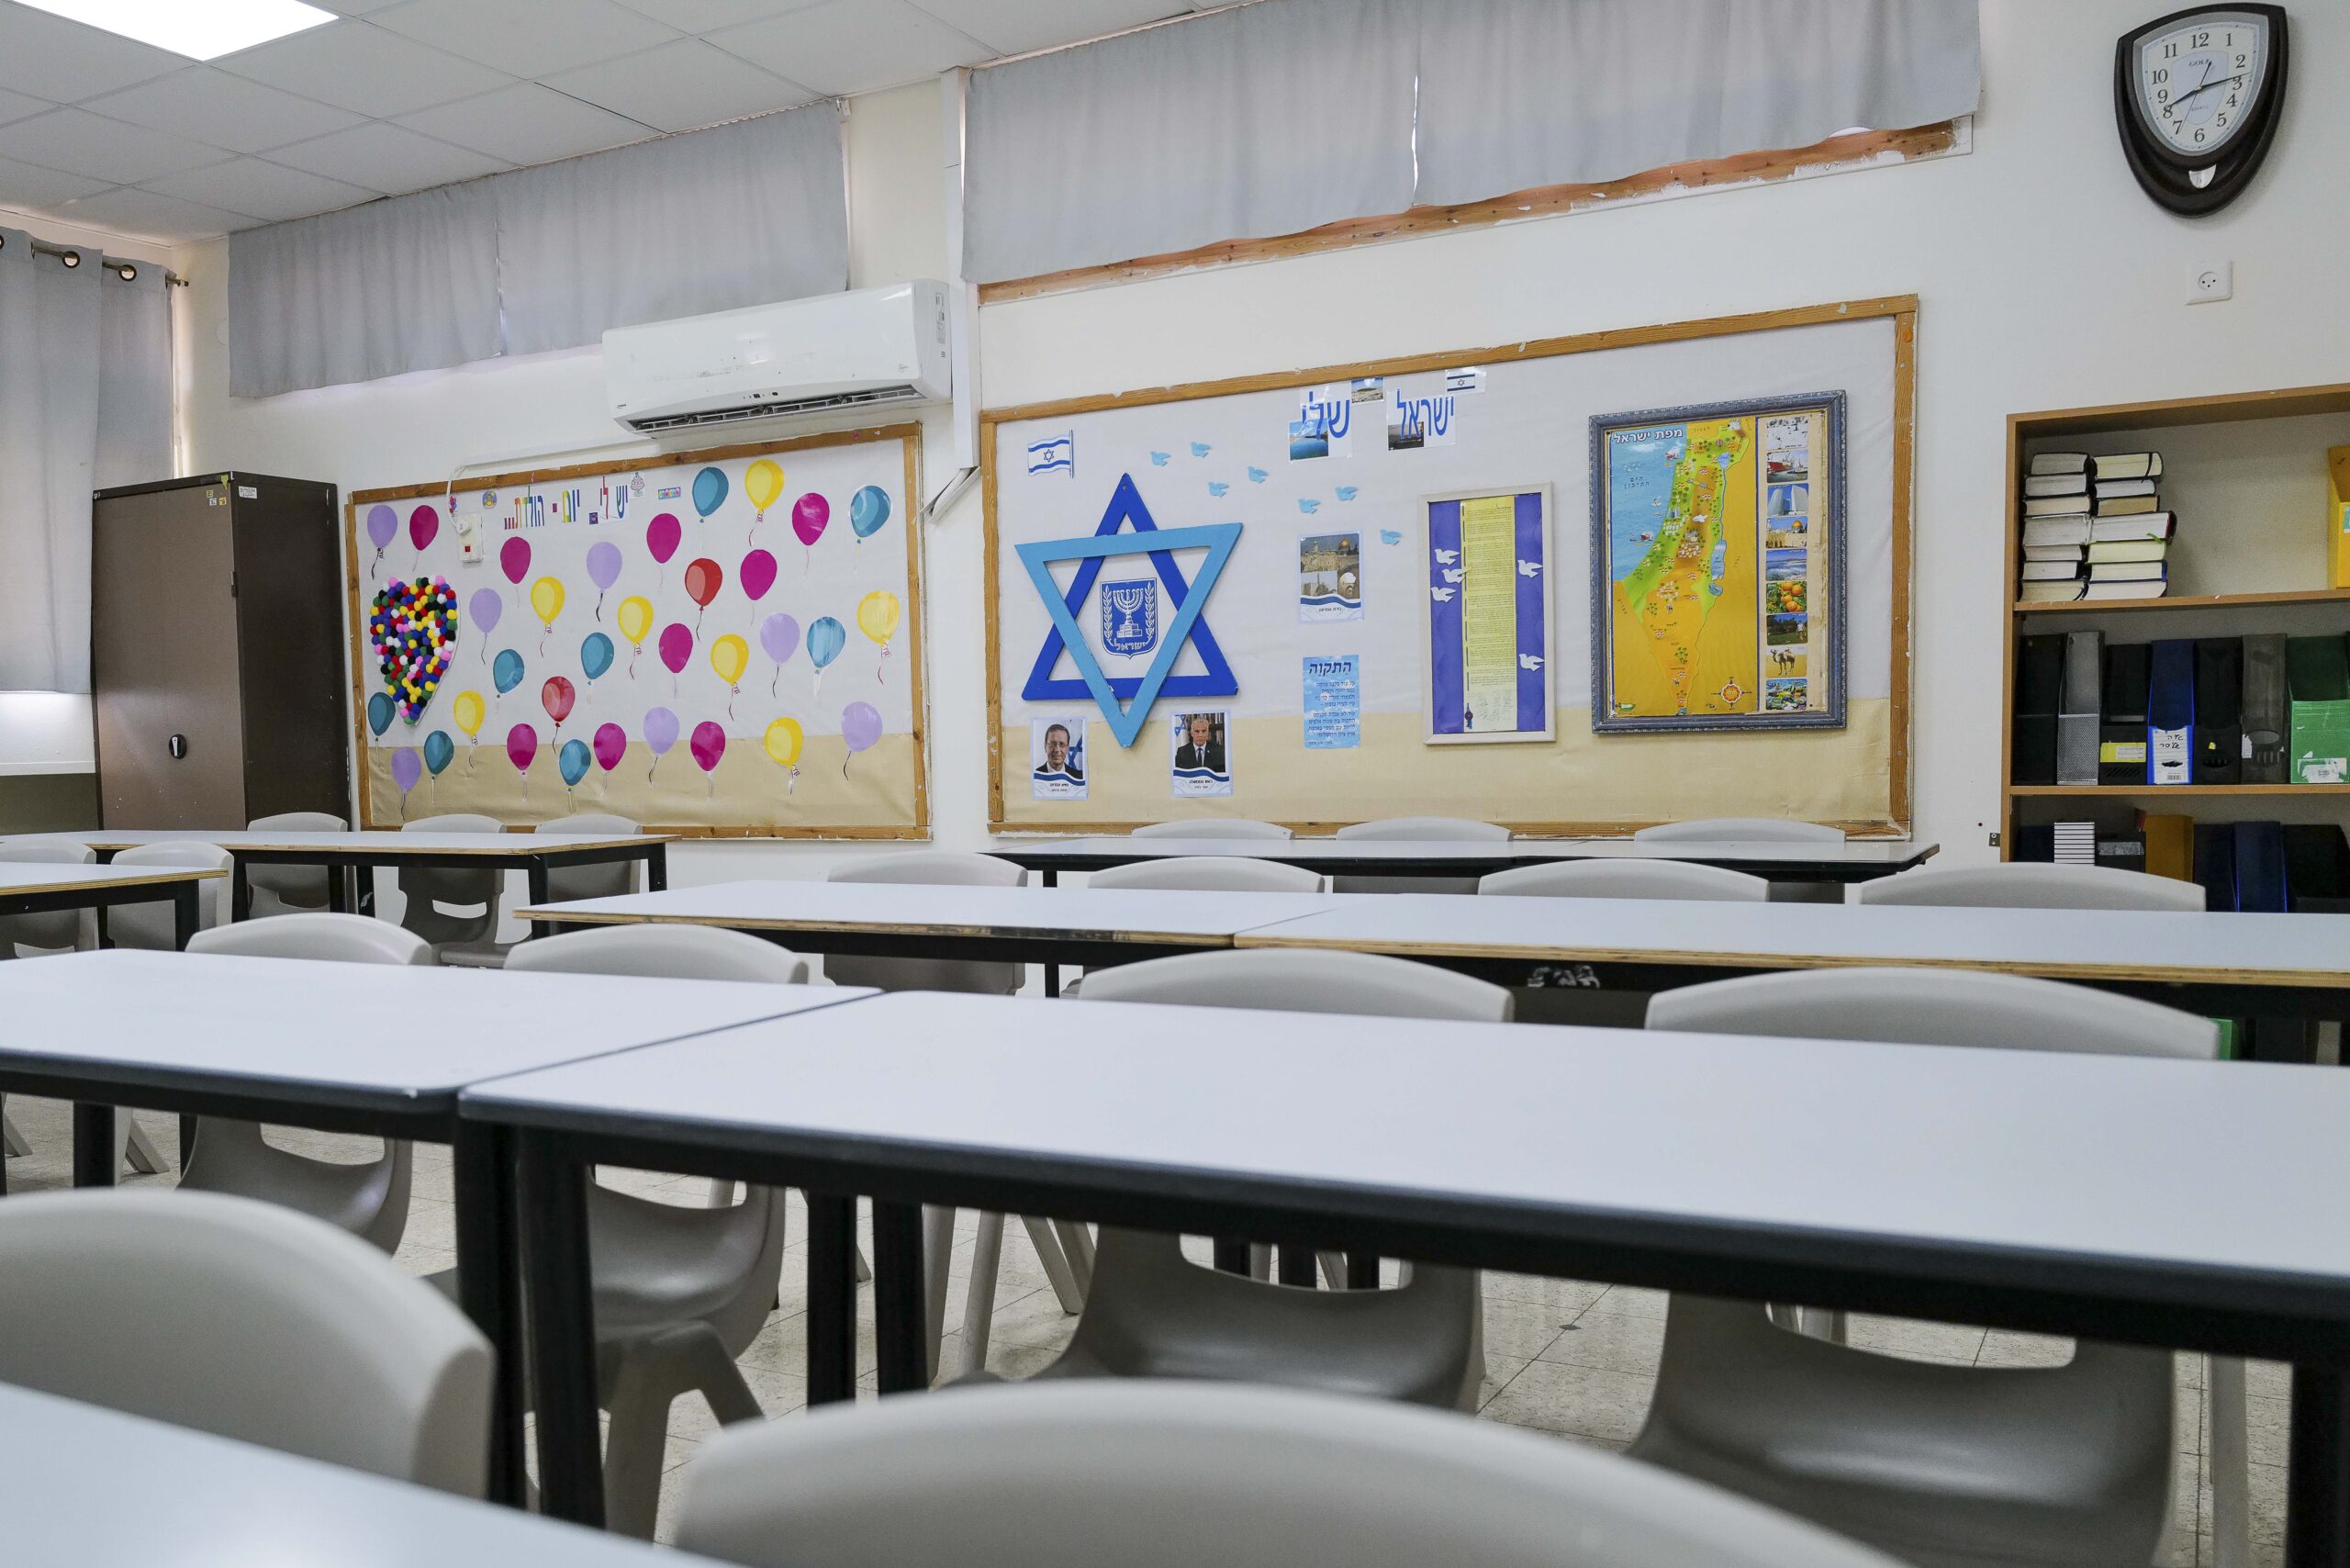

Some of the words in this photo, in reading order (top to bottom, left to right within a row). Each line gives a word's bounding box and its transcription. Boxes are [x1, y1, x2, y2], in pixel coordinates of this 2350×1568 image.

[2190, 32, 2210, 49] 12
[2225, 33, 2232, 47] 1
[2163, 43, 2178, 59] 11
[2235, 54, 2246, 68] 2
[2151, 69, 2168, 84] 10
[2232, 75, 2243, 91] 3
[2157, 89, 2168, 103] 9
[2226, 94, 2238, 107] 4
[2163, 105, 2173, 119] 8
[2217, 112, 2227, 127] 5
[2172, 120, 2183, 135] 7
[2194, 128, 2205, 142] 6
[1397, 388, 1454, 440] ישראל
[1614, 431, 1651, 444] ישראל
[1655, 429, 1684, 440] מפת
[1113, 638, 1147, 651] ישראל
